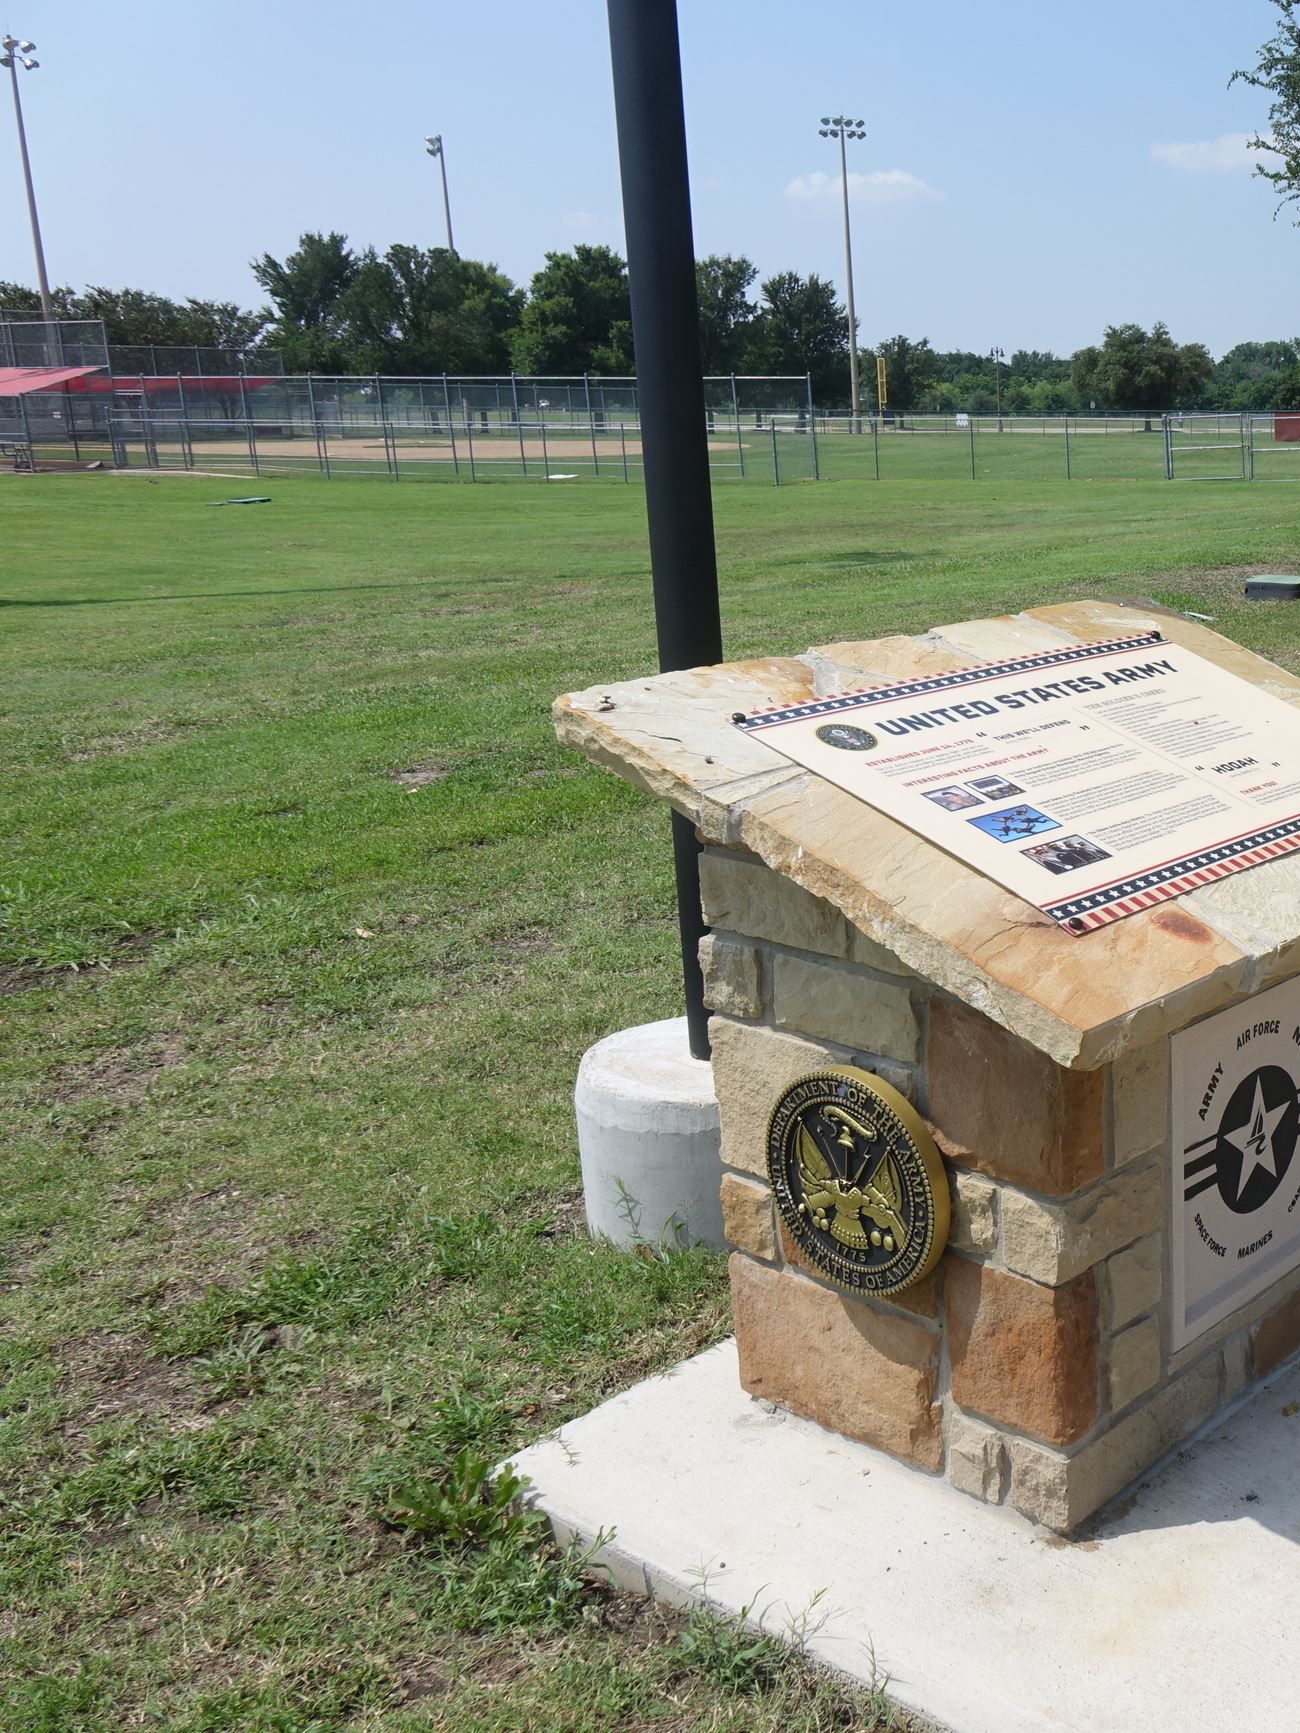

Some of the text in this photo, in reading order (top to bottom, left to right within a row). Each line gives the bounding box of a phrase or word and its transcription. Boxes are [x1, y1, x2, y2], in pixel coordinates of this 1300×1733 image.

[875, 659, 1178, 736] UNITED STATES ARMY
[993, 733, 1015, 742] THIS
[1013, 726, 1041, 737] WE'LL
[1039, 719, 1071, 730] DEFEND
[864, 751, 921, 767] ESTABLISHED
[920, 746, 942, 755] JUNE
[954, 738, 974, 747] 1775
[902, 748, 1049, 788] INTERESTING FACTS ABOUT THE ARMY
[1211, 756, 1260, 774] HOOAH
[1240, 785, 1262, 795] THANK
[1236, 1019, 1281, 1052] AIR FORCE
[1198, 1061, 1225, 1122] ARMY
[772, 1081, 929, 1206] DEPARTMENT OF THE ARMY
[771, 1164, 929, 1290] UNITED STATES OF AMERICA
[1194, 1213, 1227, 1258] SPACE FORCE
[836, 1243, 867, 1263] 1775
[1237, 1230, 1273, 1260] MARINES
